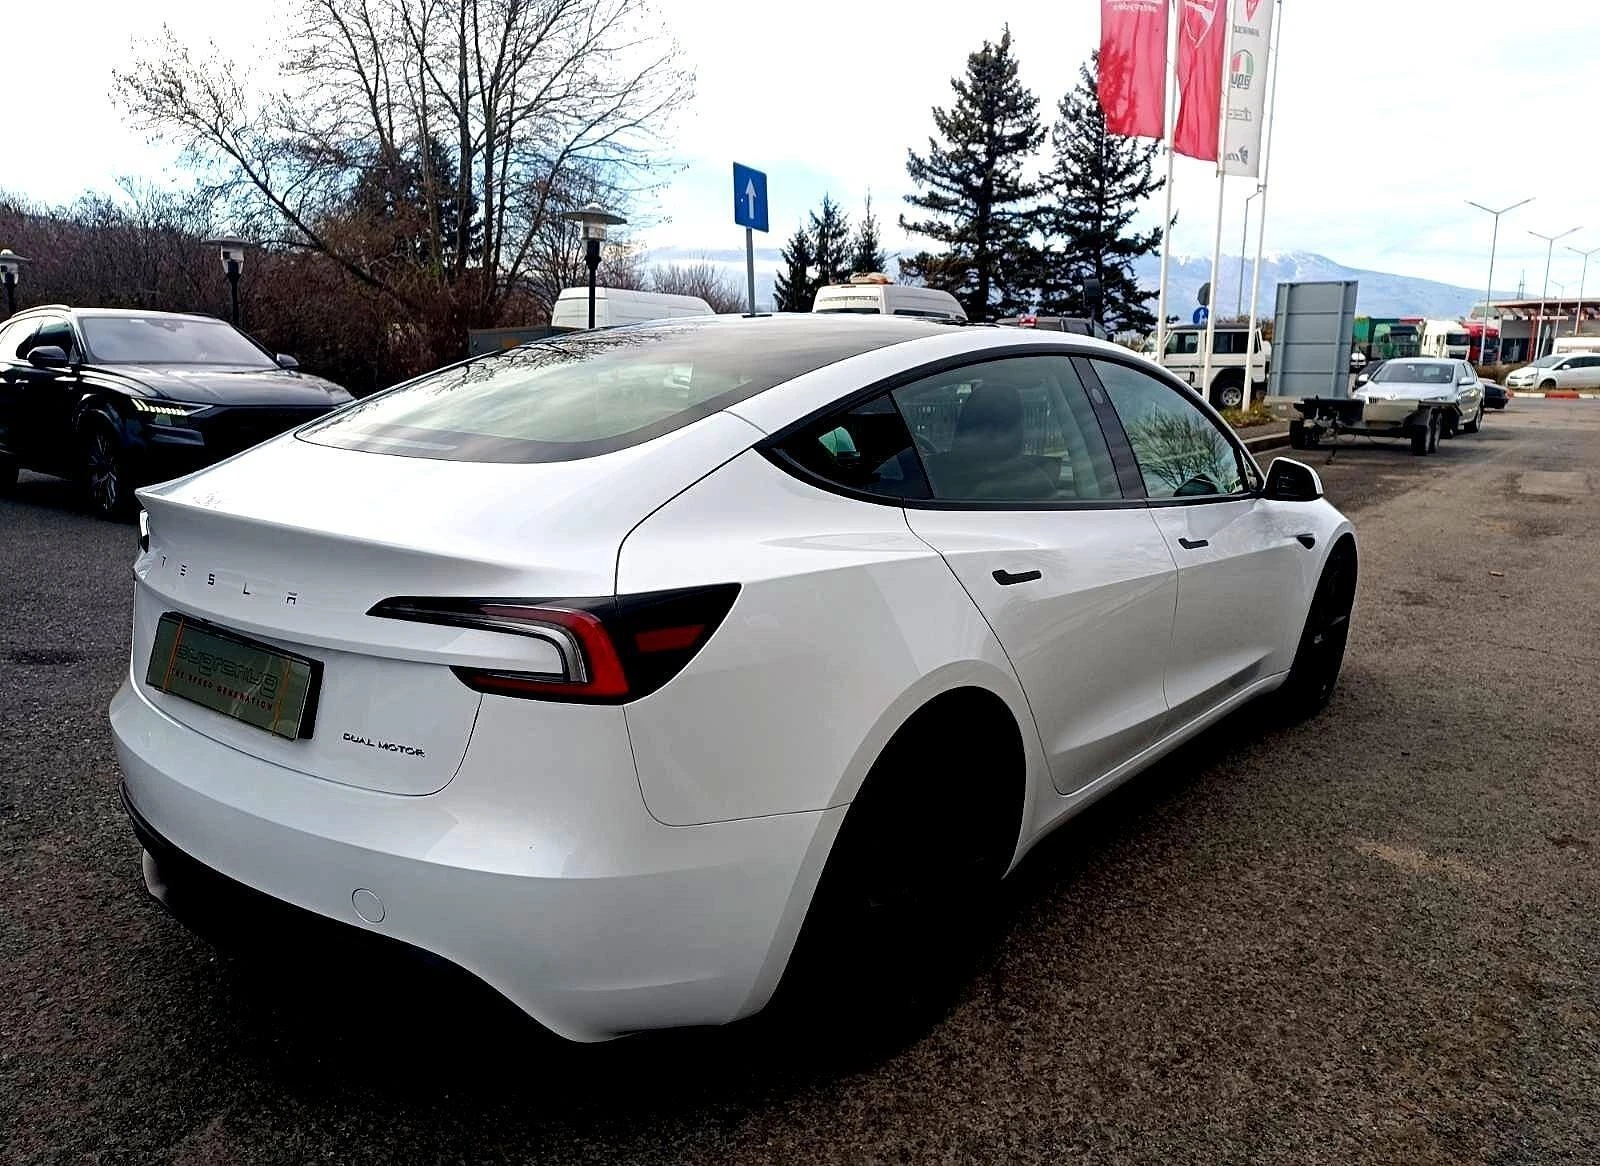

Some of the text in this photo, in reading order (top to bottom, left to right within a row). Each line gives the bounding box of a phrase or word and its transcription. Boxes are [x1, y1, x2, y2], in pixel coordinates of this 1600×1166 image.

[161, 555, 298, 606] TESLA
[216, 686, 273, 711] GENERATION
[343, 732, 425, 758] DUAL MOTOR
